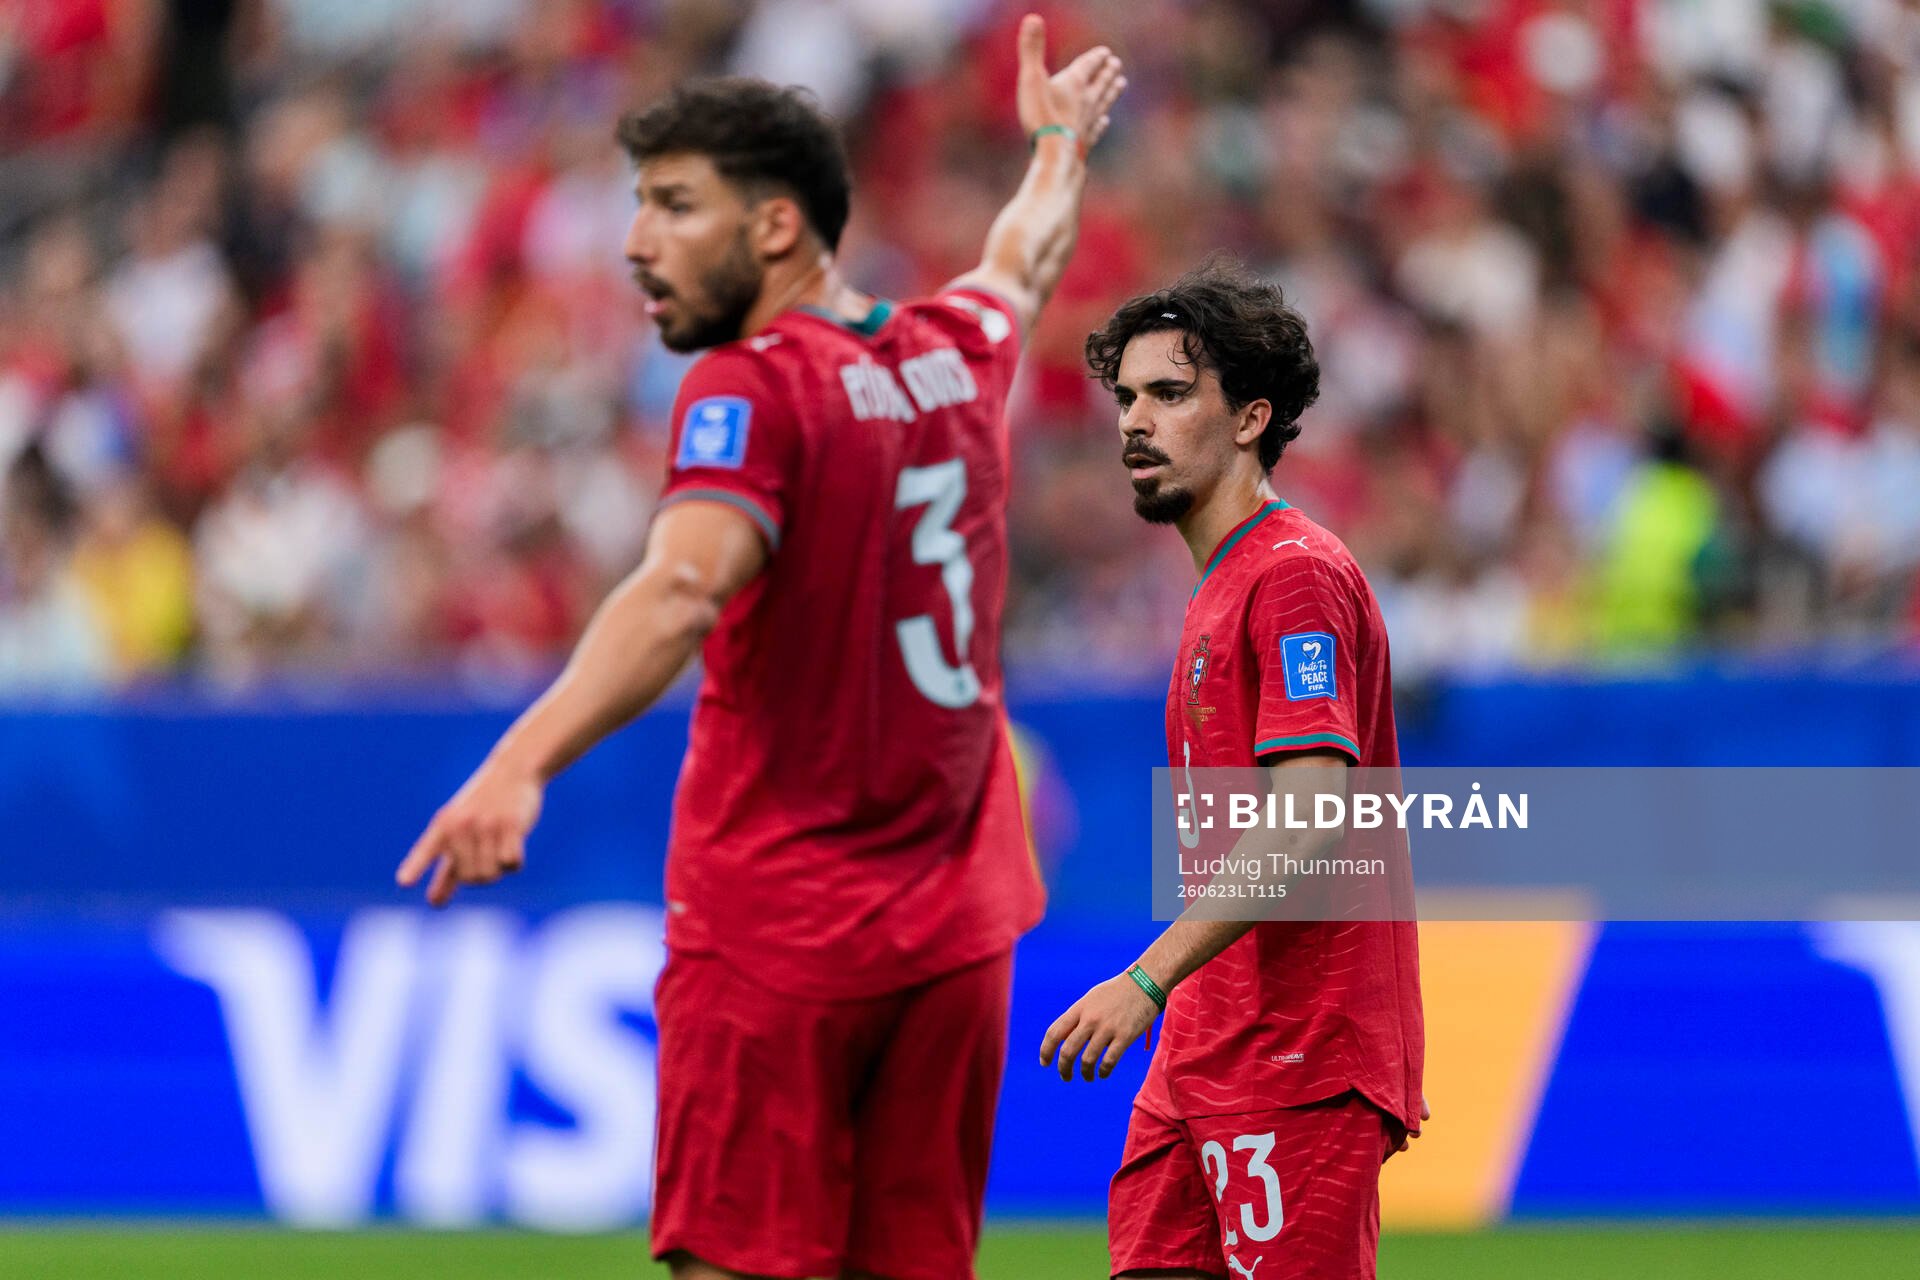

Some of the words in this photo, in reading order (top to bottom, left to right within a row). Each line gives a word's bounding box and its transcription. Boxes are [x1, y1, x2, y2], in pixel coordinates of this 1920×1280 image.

[894, 457, 981, 710] 3
[1298, 661, 1318, 674] Unite
[1301, 671, 1329, 685] PEACE
[1201, 1131, 1284, 1246] 23
